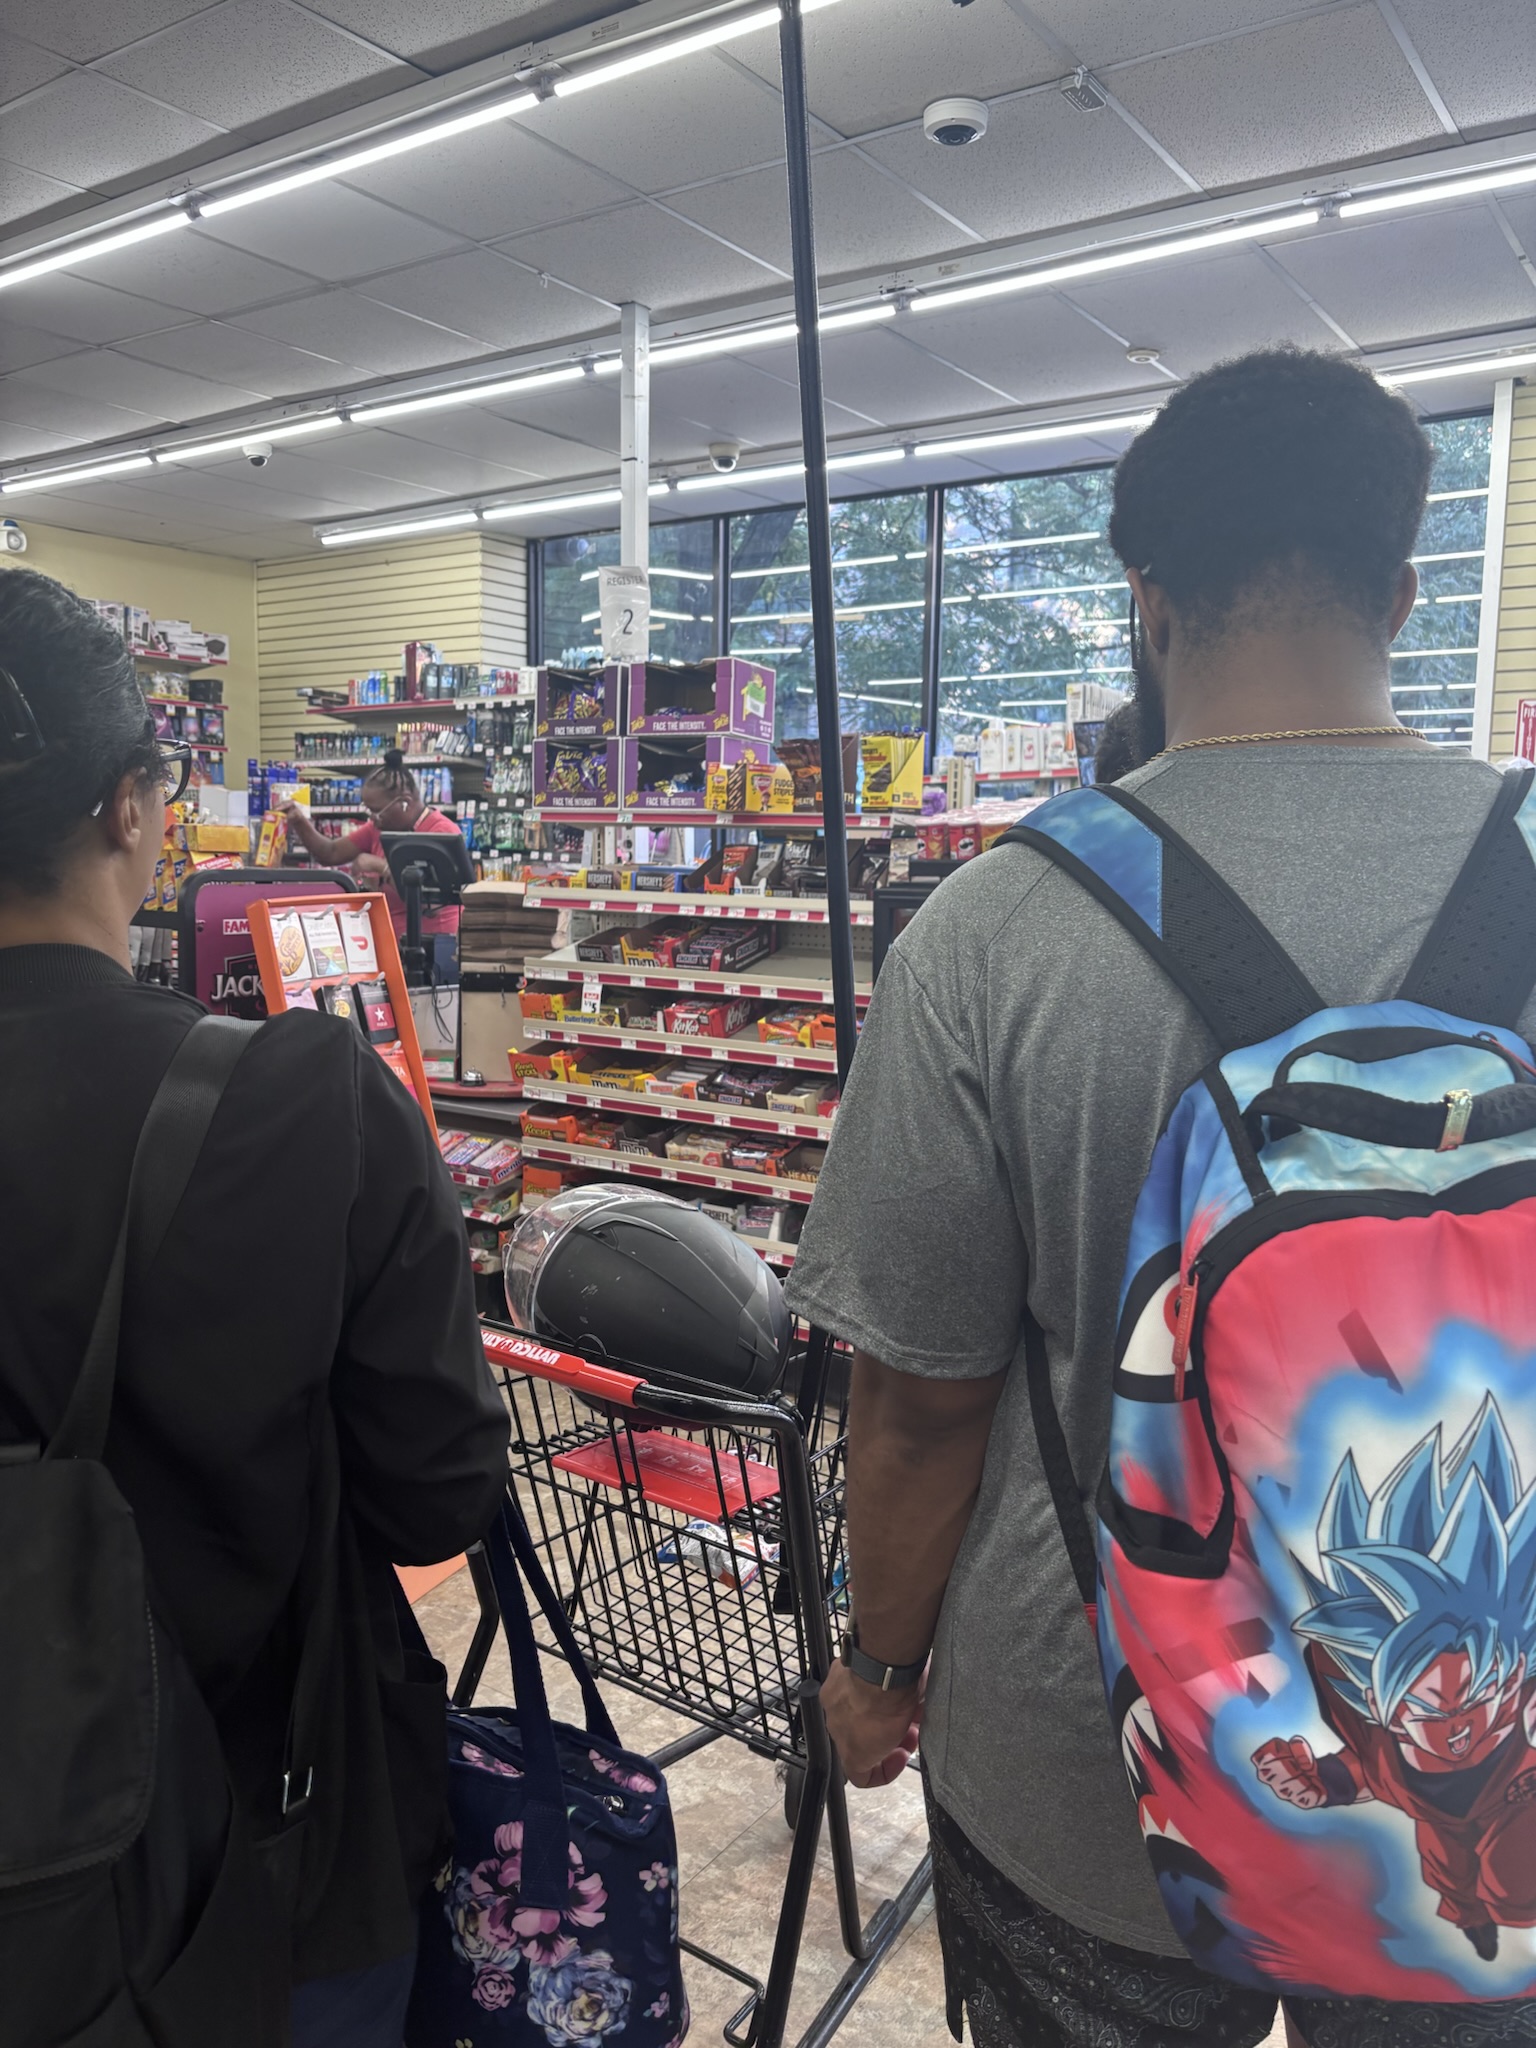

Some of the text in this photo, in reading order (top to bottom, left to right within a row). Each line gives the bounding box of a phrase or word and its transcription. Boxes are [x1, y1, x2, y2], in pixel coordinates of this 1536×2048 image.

[607, 575, 645, 586] REGISTER
[622, 608, 634, 635] 2
[554, 726, 566, 735] FACE
[566, 725, 575, 735] THE
[652, 721, 667, 731] FACE
[667, 721, 679, 731] THE
[774, 779, 794, 787] FUDGE
[774, 788, 795, 796] STRIPES
[552, 797, 564, 806] FACE
[564, 797, 574, 806] THE
[646, 797, 659, 806] FACE
[659, 797, 671, 806] THE
[637, 876, 663, 887] HERSHEY'S
[564, 1014, 597, 1024] Butterfinger
[509, 1342, 560, 1365] DOLLAR
